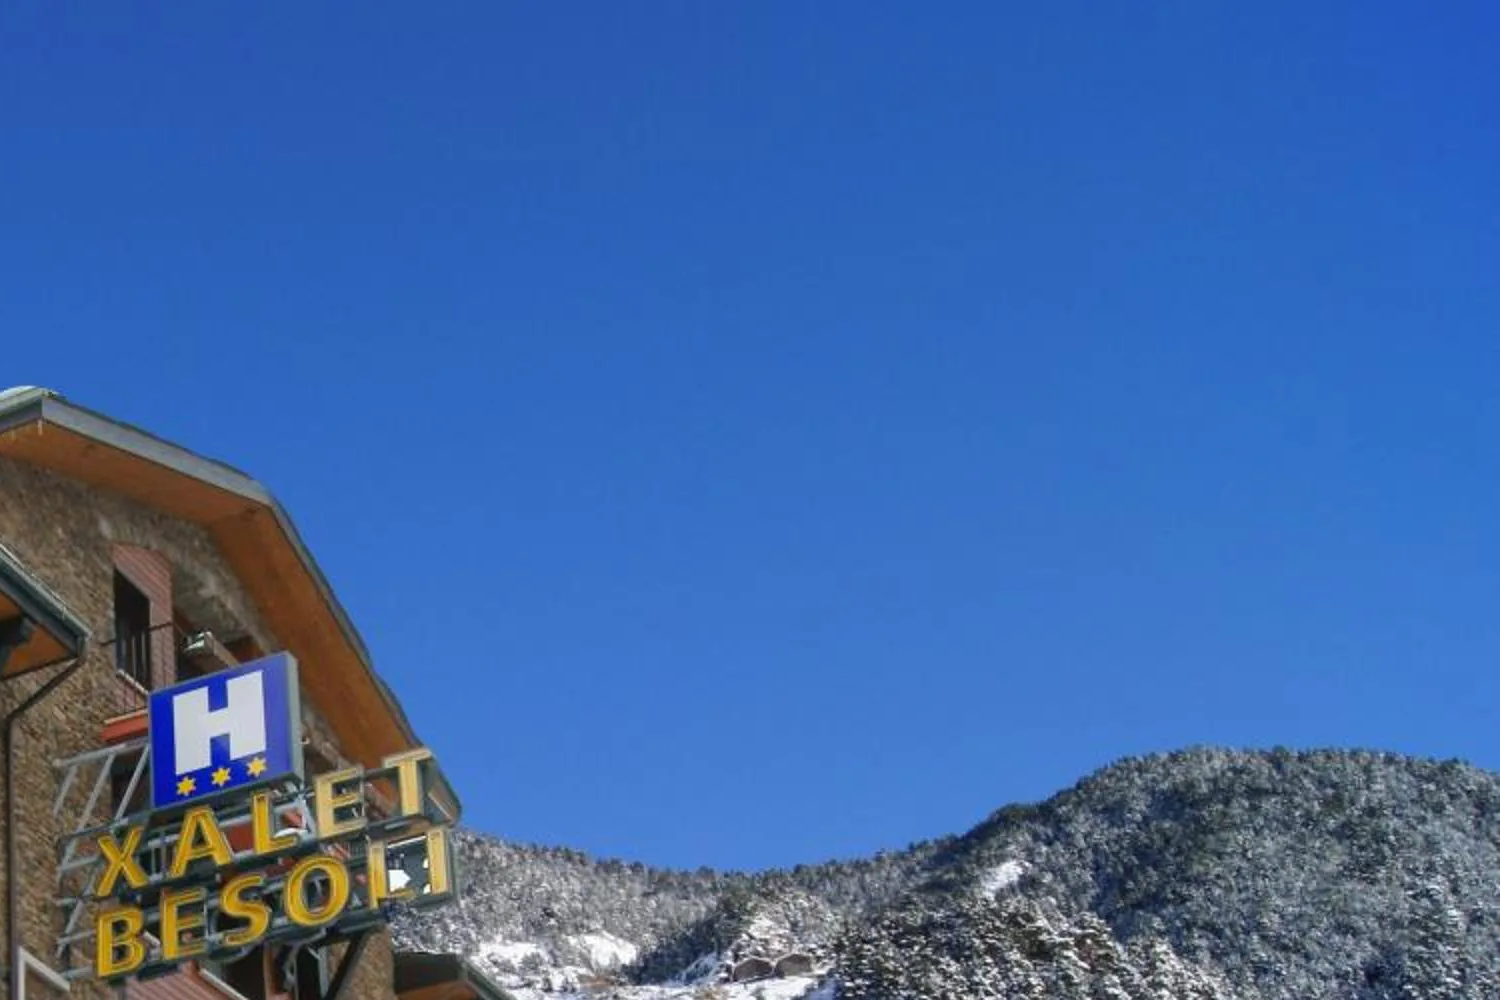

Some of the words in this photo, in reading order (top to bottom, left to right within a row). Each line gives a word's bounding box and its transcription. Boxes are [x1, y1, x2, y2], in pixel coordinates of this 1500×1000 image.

[172, 669, 267, 776] H
[97, 748, 432, 897] XALET
[98, 827, 449, 978] BESOLI
